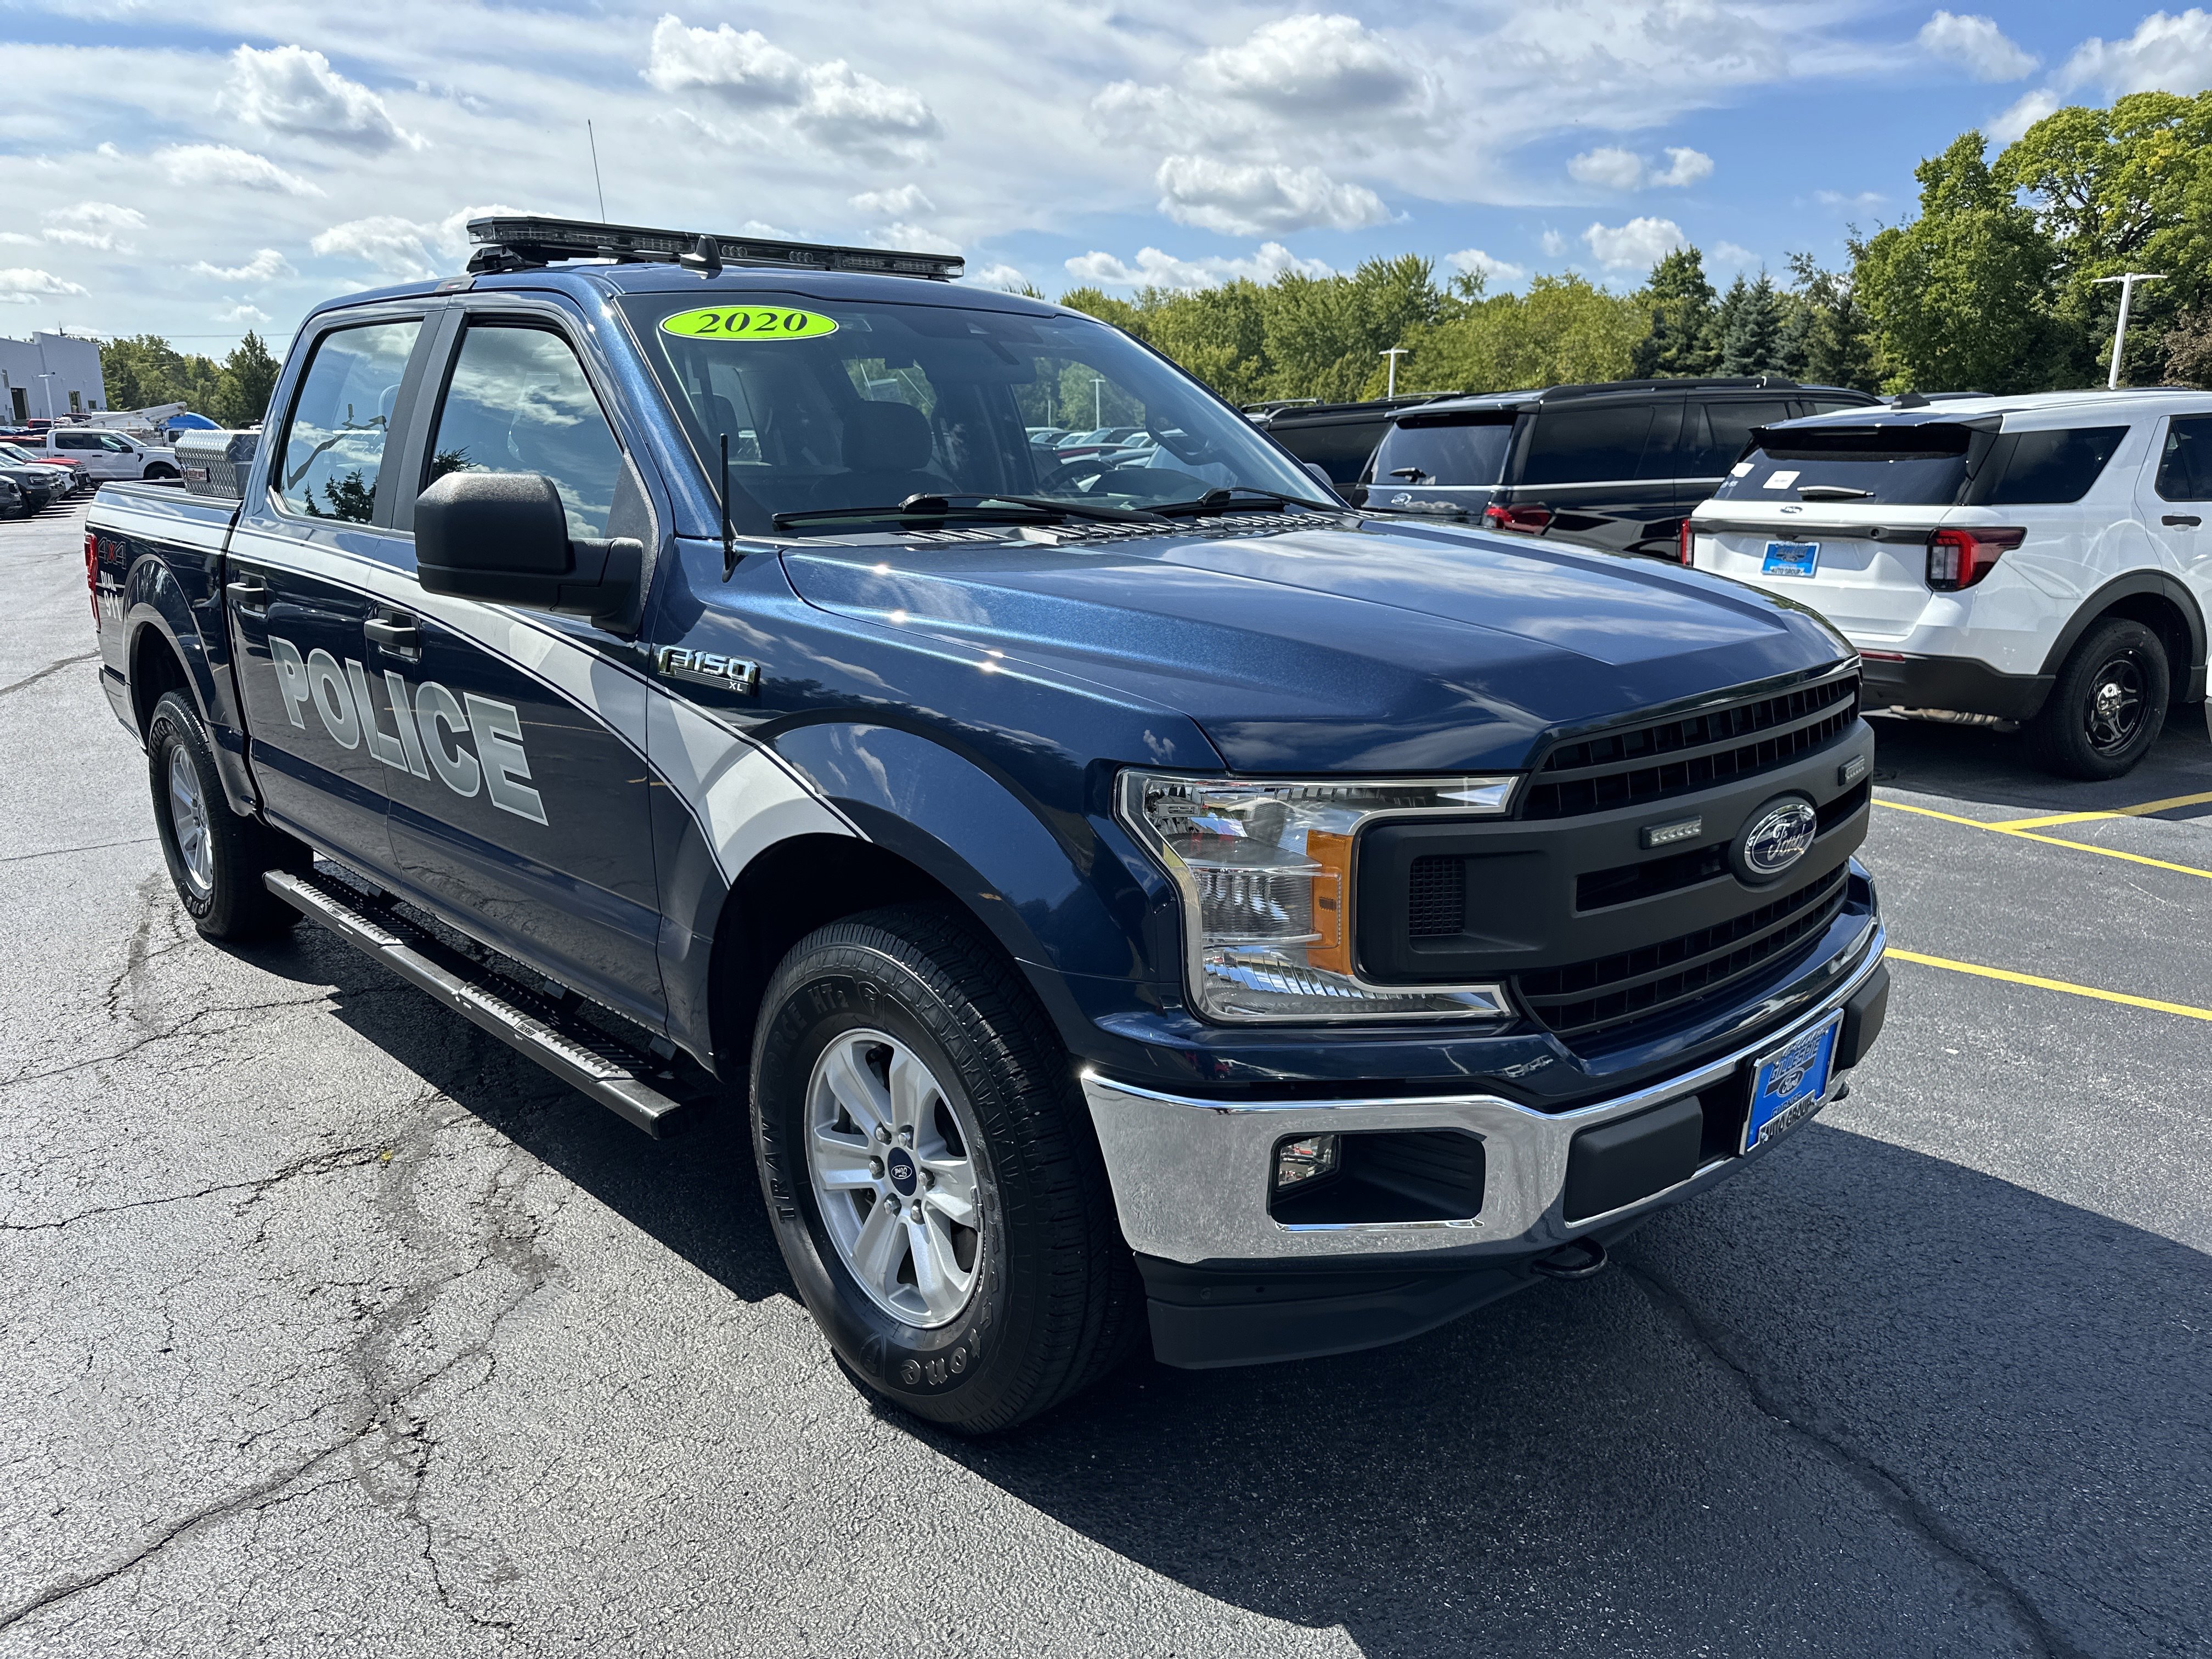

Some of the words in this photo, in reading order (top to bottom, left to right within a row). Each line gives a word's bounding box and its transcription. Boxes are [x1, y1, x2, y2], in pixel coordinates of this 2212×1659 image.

[695, 312, 808, 334] 2020
[100, 571, 116, 591] DIAL
[104, 590, 122, 621] 911
[729, 681, 743, 691] XL
[268, 635, 549, 826] POLICE
[1767, 823, 1805, 861] Ford
[1769, 1039, 1820, 1082] GILLESPIE
[1782, 1073, 1798, 1093] Ford
[894, 1167, 908, 1178] Ford
